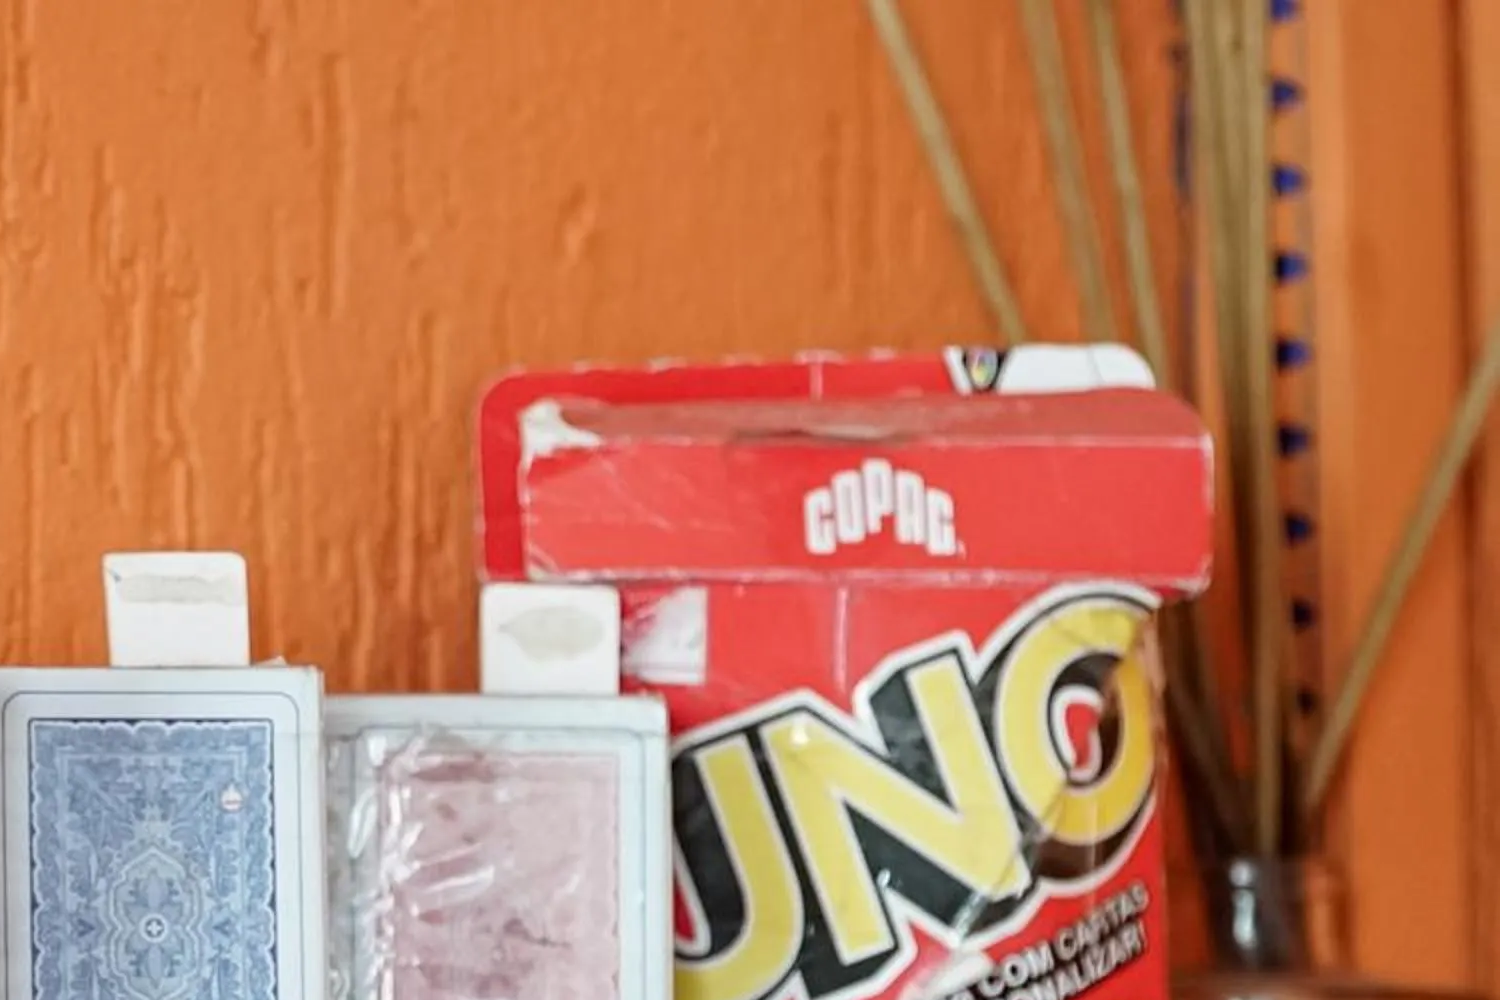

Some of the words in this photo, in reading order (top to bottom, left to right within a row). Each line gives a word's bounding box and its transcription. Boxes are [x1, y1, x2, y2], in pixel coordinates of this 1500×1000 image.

[804, 457, 956, 557] COPAG
[979, 942, 1055, 997] COM
[1055, 881, 1150, 962] CARTAS
